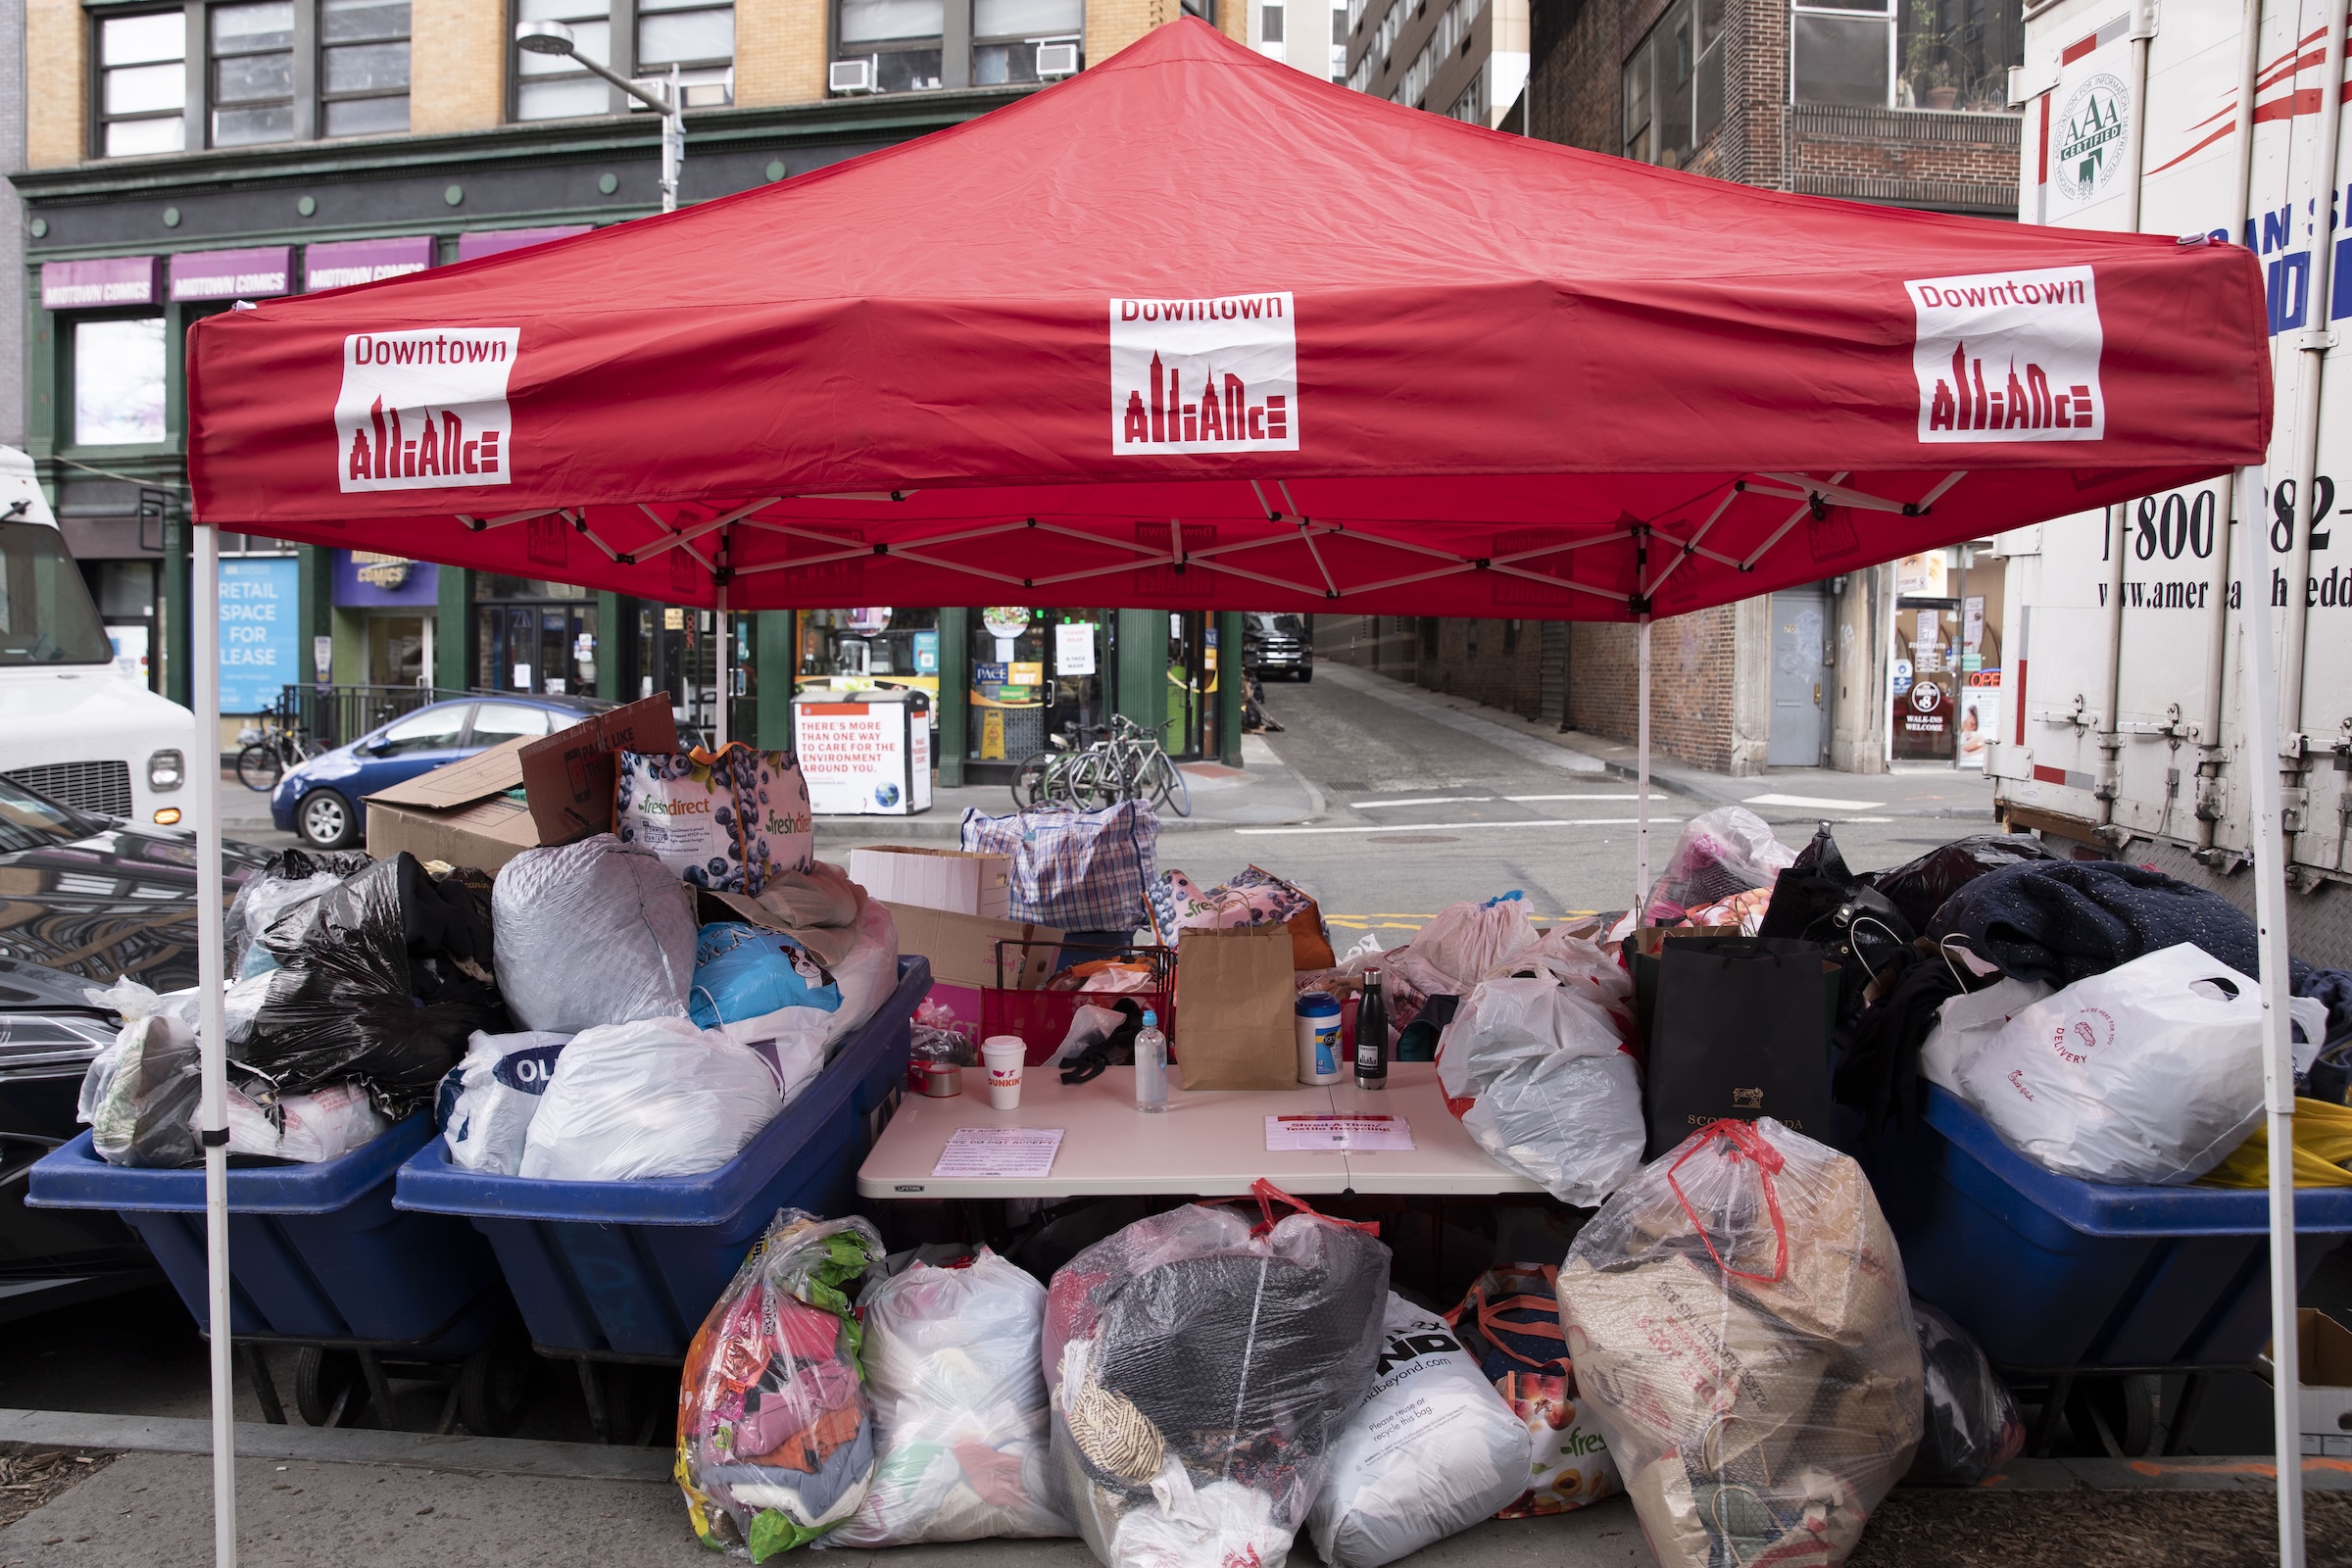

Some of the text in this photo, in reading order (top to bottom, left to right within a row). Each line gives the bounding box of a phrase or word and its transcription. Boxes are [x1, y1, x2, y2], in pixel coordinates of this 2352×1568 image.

[2080, 80, 2093, 94] FOR
[2064, 93, 2119, 147] AAA
[2063, 127, 2119, 160] CERTIFIED
[174, 271, 286, 298] MIDTOWN COMICS
[309, 267, 372, 289] MIDTOWN
[45, 280, 151, 306] MIDTOWN COMICS
[1917, 279, 2085, 308] Downtown
[1121, 297, 1283, 321] Downtown
[356, 334, 507, 366] Downtown
[219, 582, 279, 599] RETAIL
[220, 604, 277, 621] SPACE
[229, 626, 268, 644] FOR
[1922, 628, 1936, 639] 70
[220, 648, 277, 665] LEASE
[976, 667, 1007, 680] PACE
[1014, 673, 1037, 684] EBT
[1970, 672, 2001, 688] OPE
[802, 721, 882, 730] THERE'S MORE
[1906, 714, 1943, 723] WALK-INS
[611, 727, 635, 748] LIKE
[833, 732, 856, 741] ONE
[802, 743, 896, 752] TO CARE FOR THE
[803, 754, 882, 762] ENVIRONMENT
[853, 764, 877, 773] YOU.
[643, 794, 710, 816] freshdirect
[1189, 899, 1218, 916] fre
[2098, 1009, 2111, 1021] HERE
[2054, 1027, 2087, 1064] DELIVERY
[516, 1057, 558, 1083] OL
[1656, 1281, 1681, 1304] BAG
[1677, 1302, 1699, 1327] THIS
[1369, 1396, 1425, 1433] Please reuse or
[1373, 1405, 1435, 1443] recycle this bag.
[1569, 1426, 1607, 1457] fres
